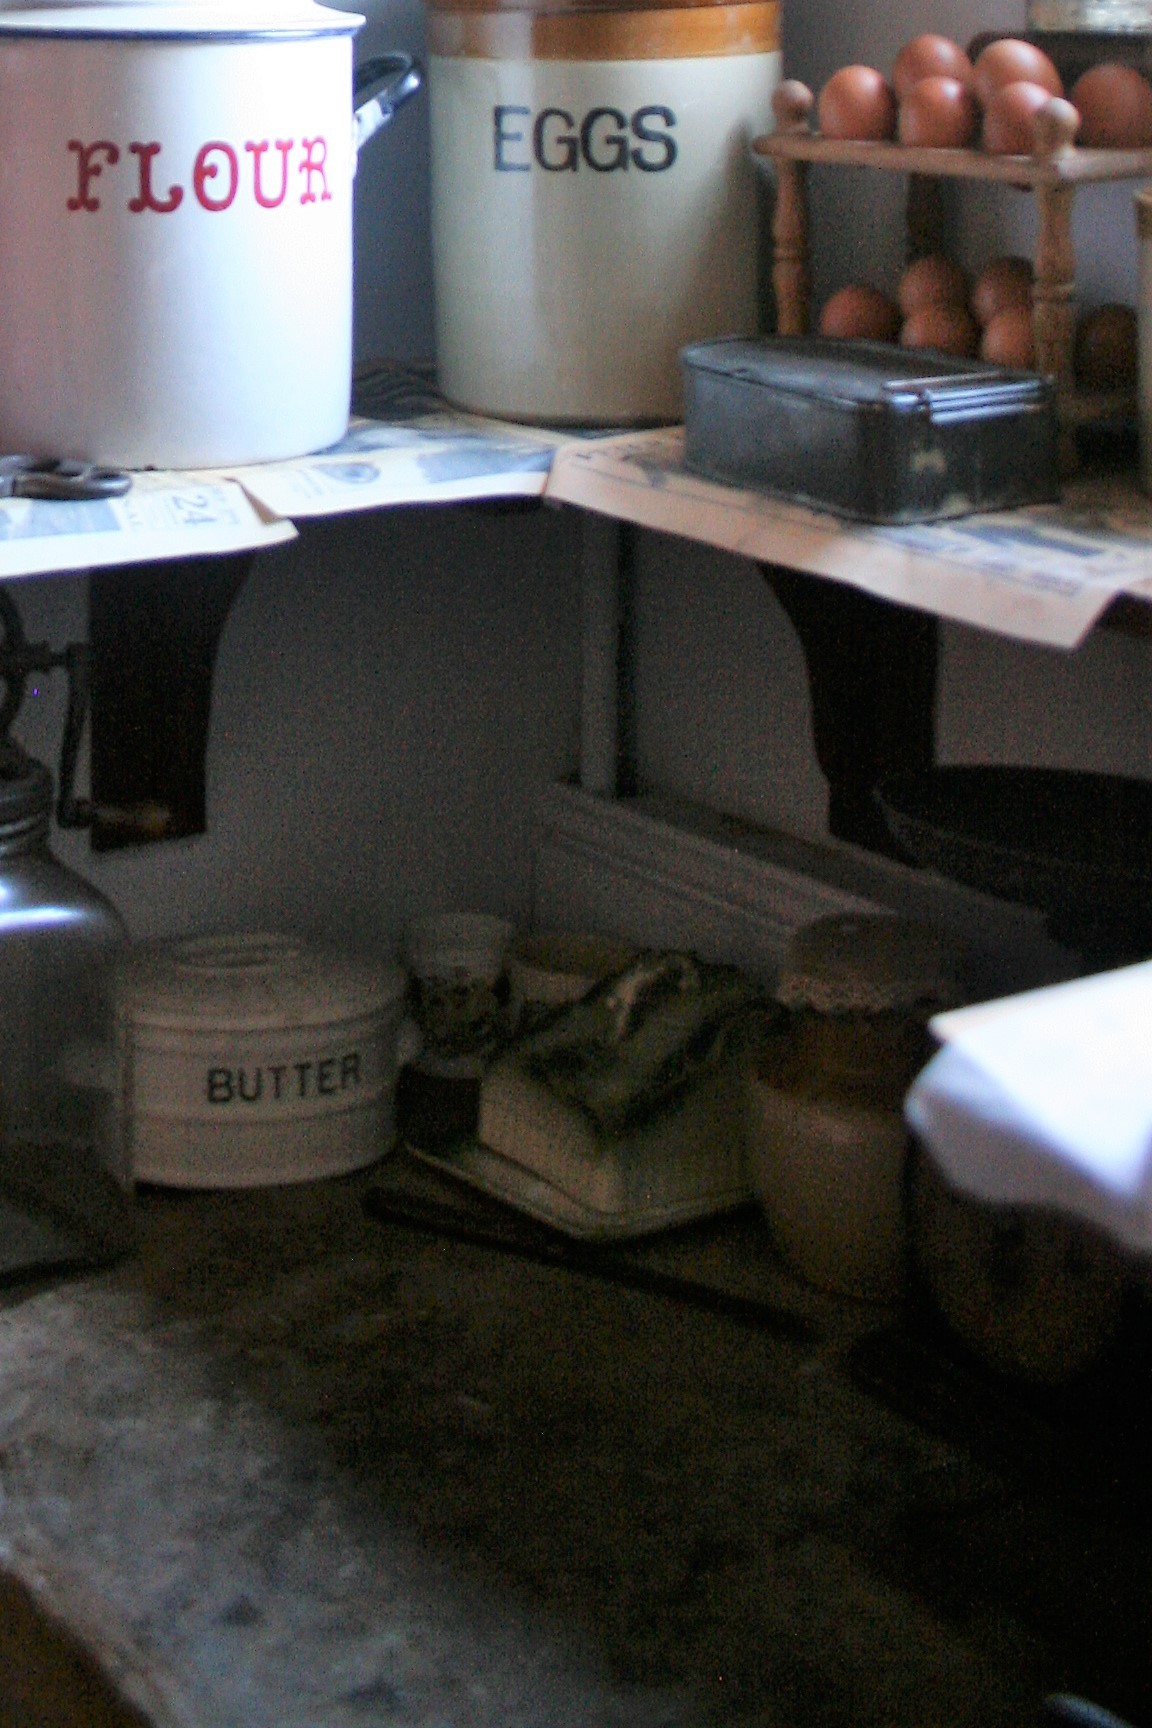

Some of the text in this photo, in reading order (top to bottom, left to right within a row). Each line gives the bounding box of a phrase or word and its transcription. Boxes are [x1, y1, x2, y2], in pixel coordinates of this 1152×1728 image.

[493, 104, 679, 173] EGGS
[66, 135, 333, 213] FLOUR
[206, 1052, 362, 1104] BUTTER
